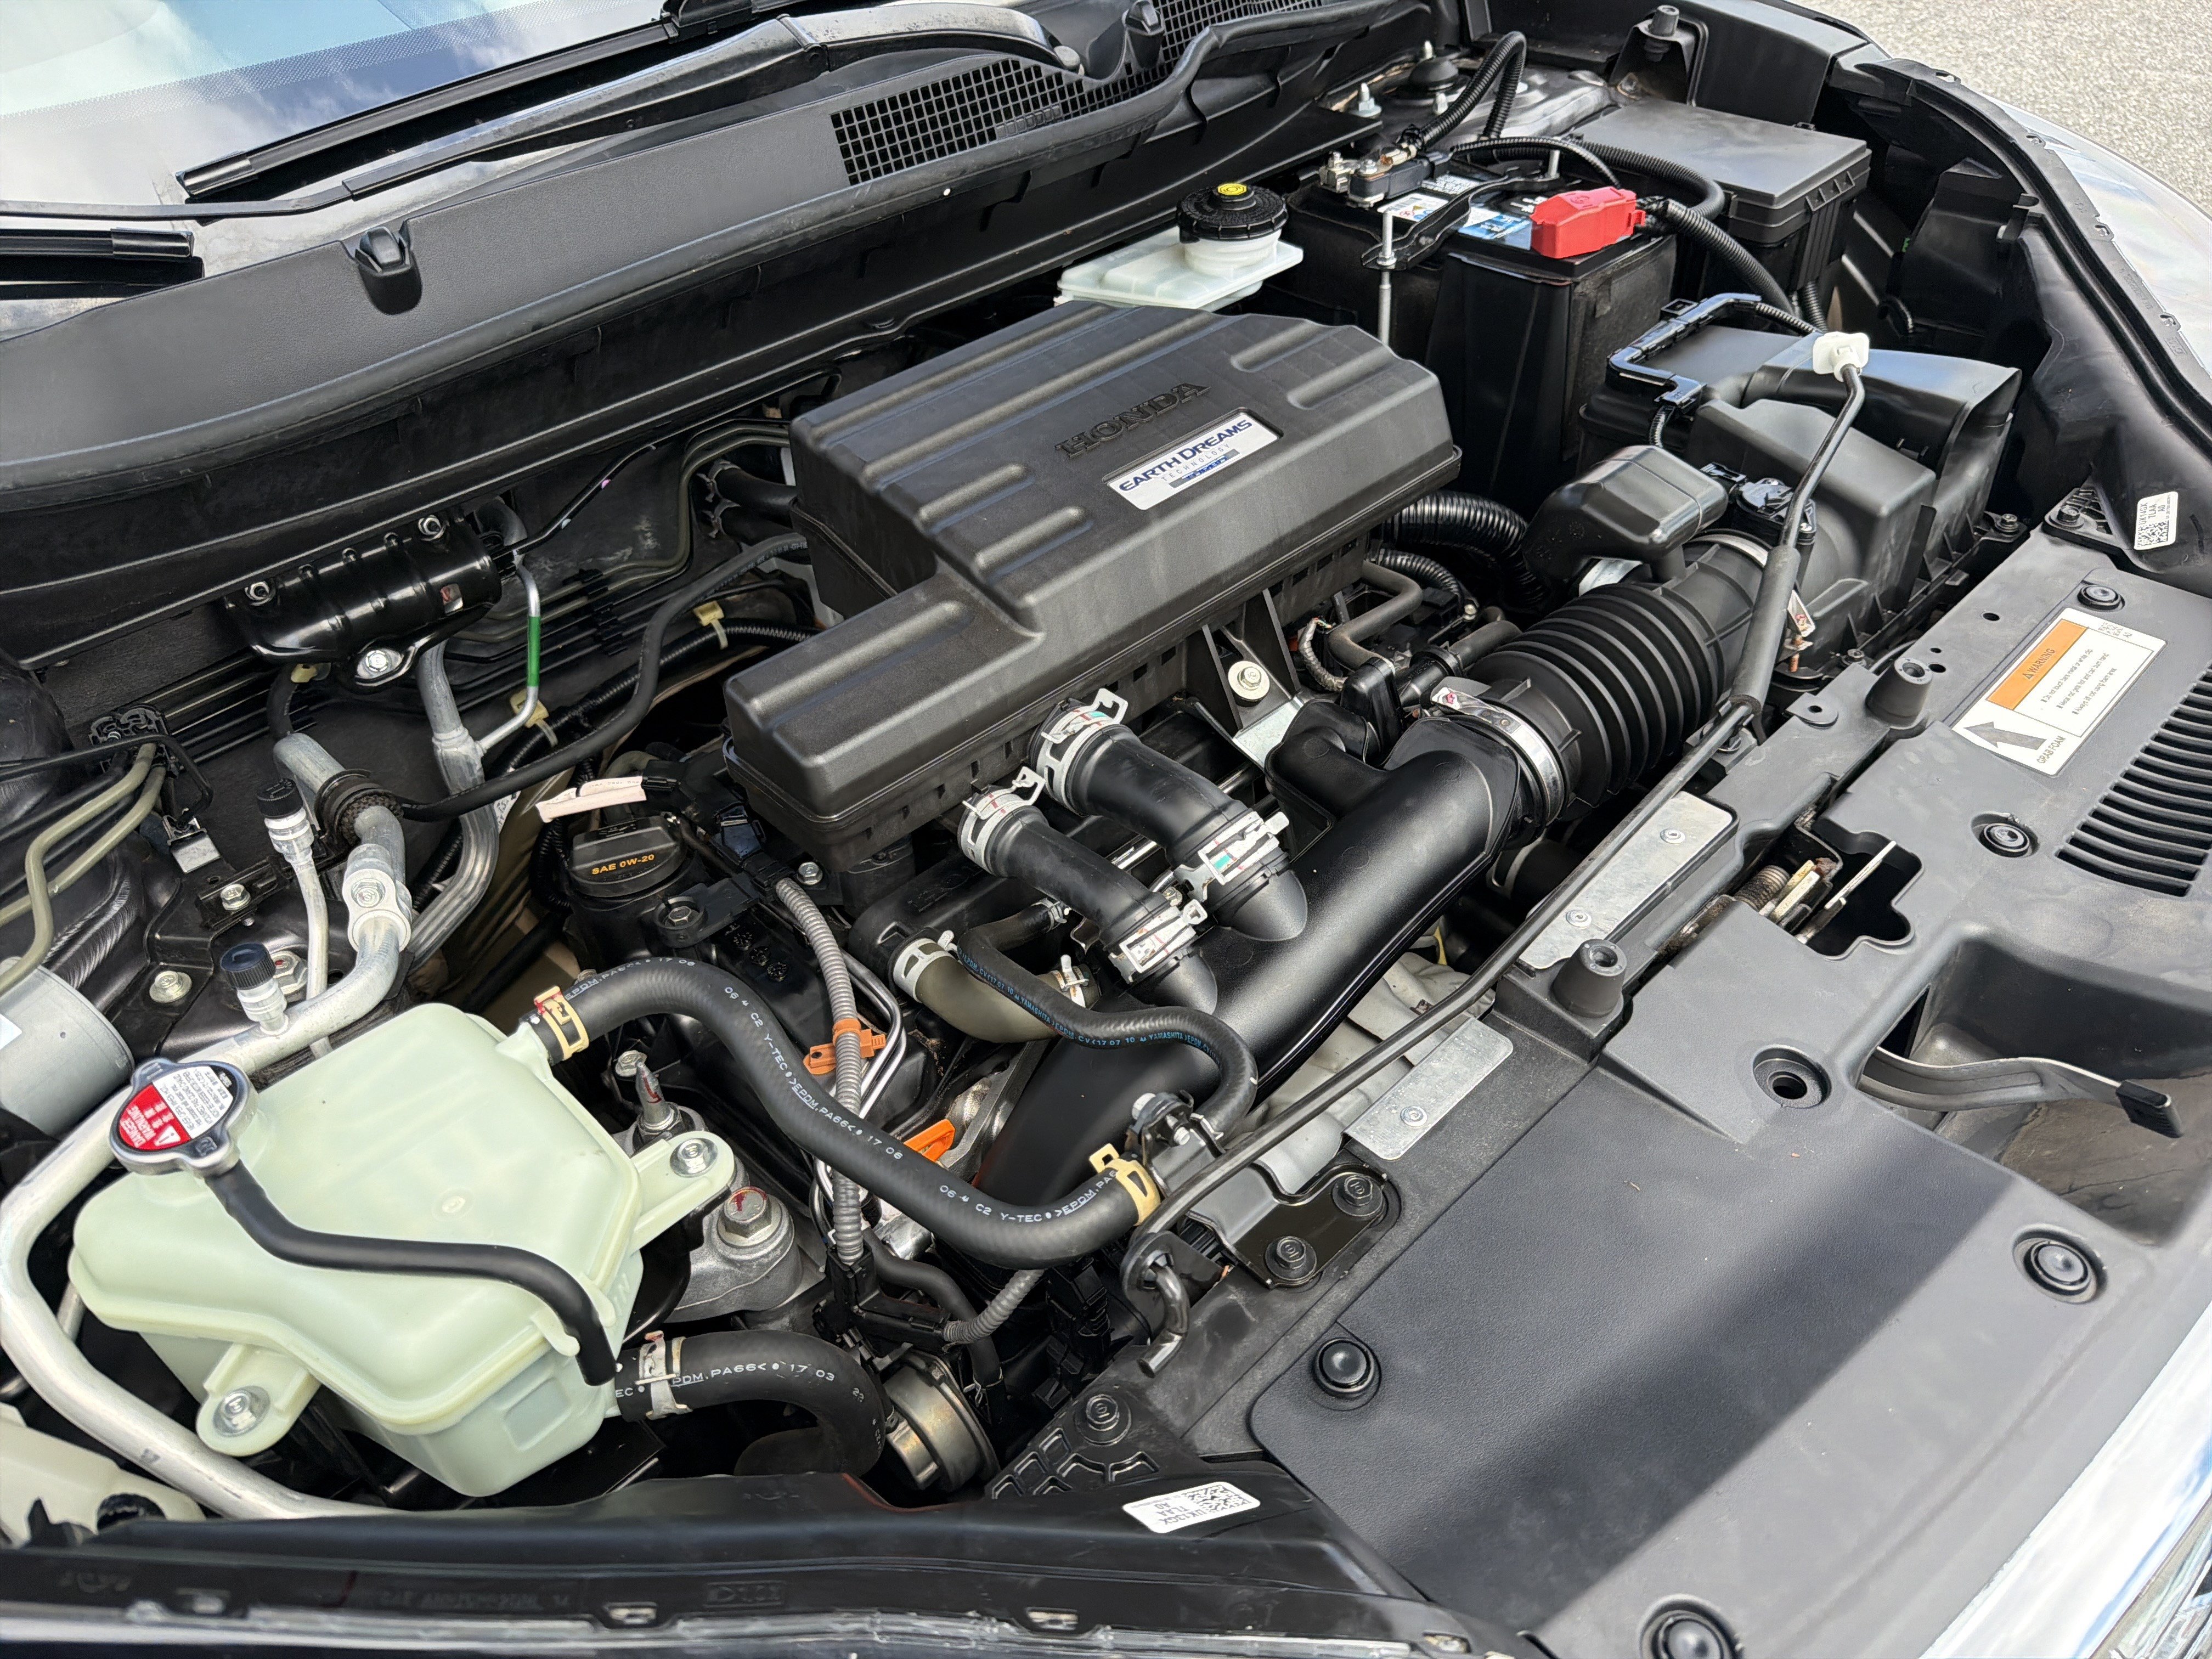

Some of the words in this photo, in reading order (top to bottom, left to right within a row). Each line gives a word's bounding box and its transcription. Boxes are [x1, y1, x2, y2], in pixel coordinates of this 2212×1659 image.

[1055, 383, 1211, 458] HONDA
[1119, 457, 1181, 492] EARTH
[1177, 420, 1253, 460] DREAMS
[1161, 443, 1231, 482] TECHNOLOGY
[2027, 648, 2055, 673] WARNING
[2036, 749, 2054, 764] GRAB
[2048, 735, 2066, 751] FOAM
[592, 864, 617, 874] SAE
[619, 854, 655, 868] 0W-20
[1021, 996, 1051, 1024] YAMASHITA
[1149, 1031, 1183, 1040] YAMASHITA
[725, 987, 739, 1000] 06
[751, 1013, 763, 1027] C2
[764, 1034, 788, 1070] Y-TEC
[867, 1136, 882, 1146] 17
[885, 1147, 903, 1159] 06
[120, 1118, 146, 1148] DANGER
[939, 1185, 957, 1198] 06
[975, 1204, 992, 1216] C2
[1000, 1212, 1043, 1222] Y-TEC
[790, 1364, 809, 1373] 17
[816, 1369, 835, 1381] 03
